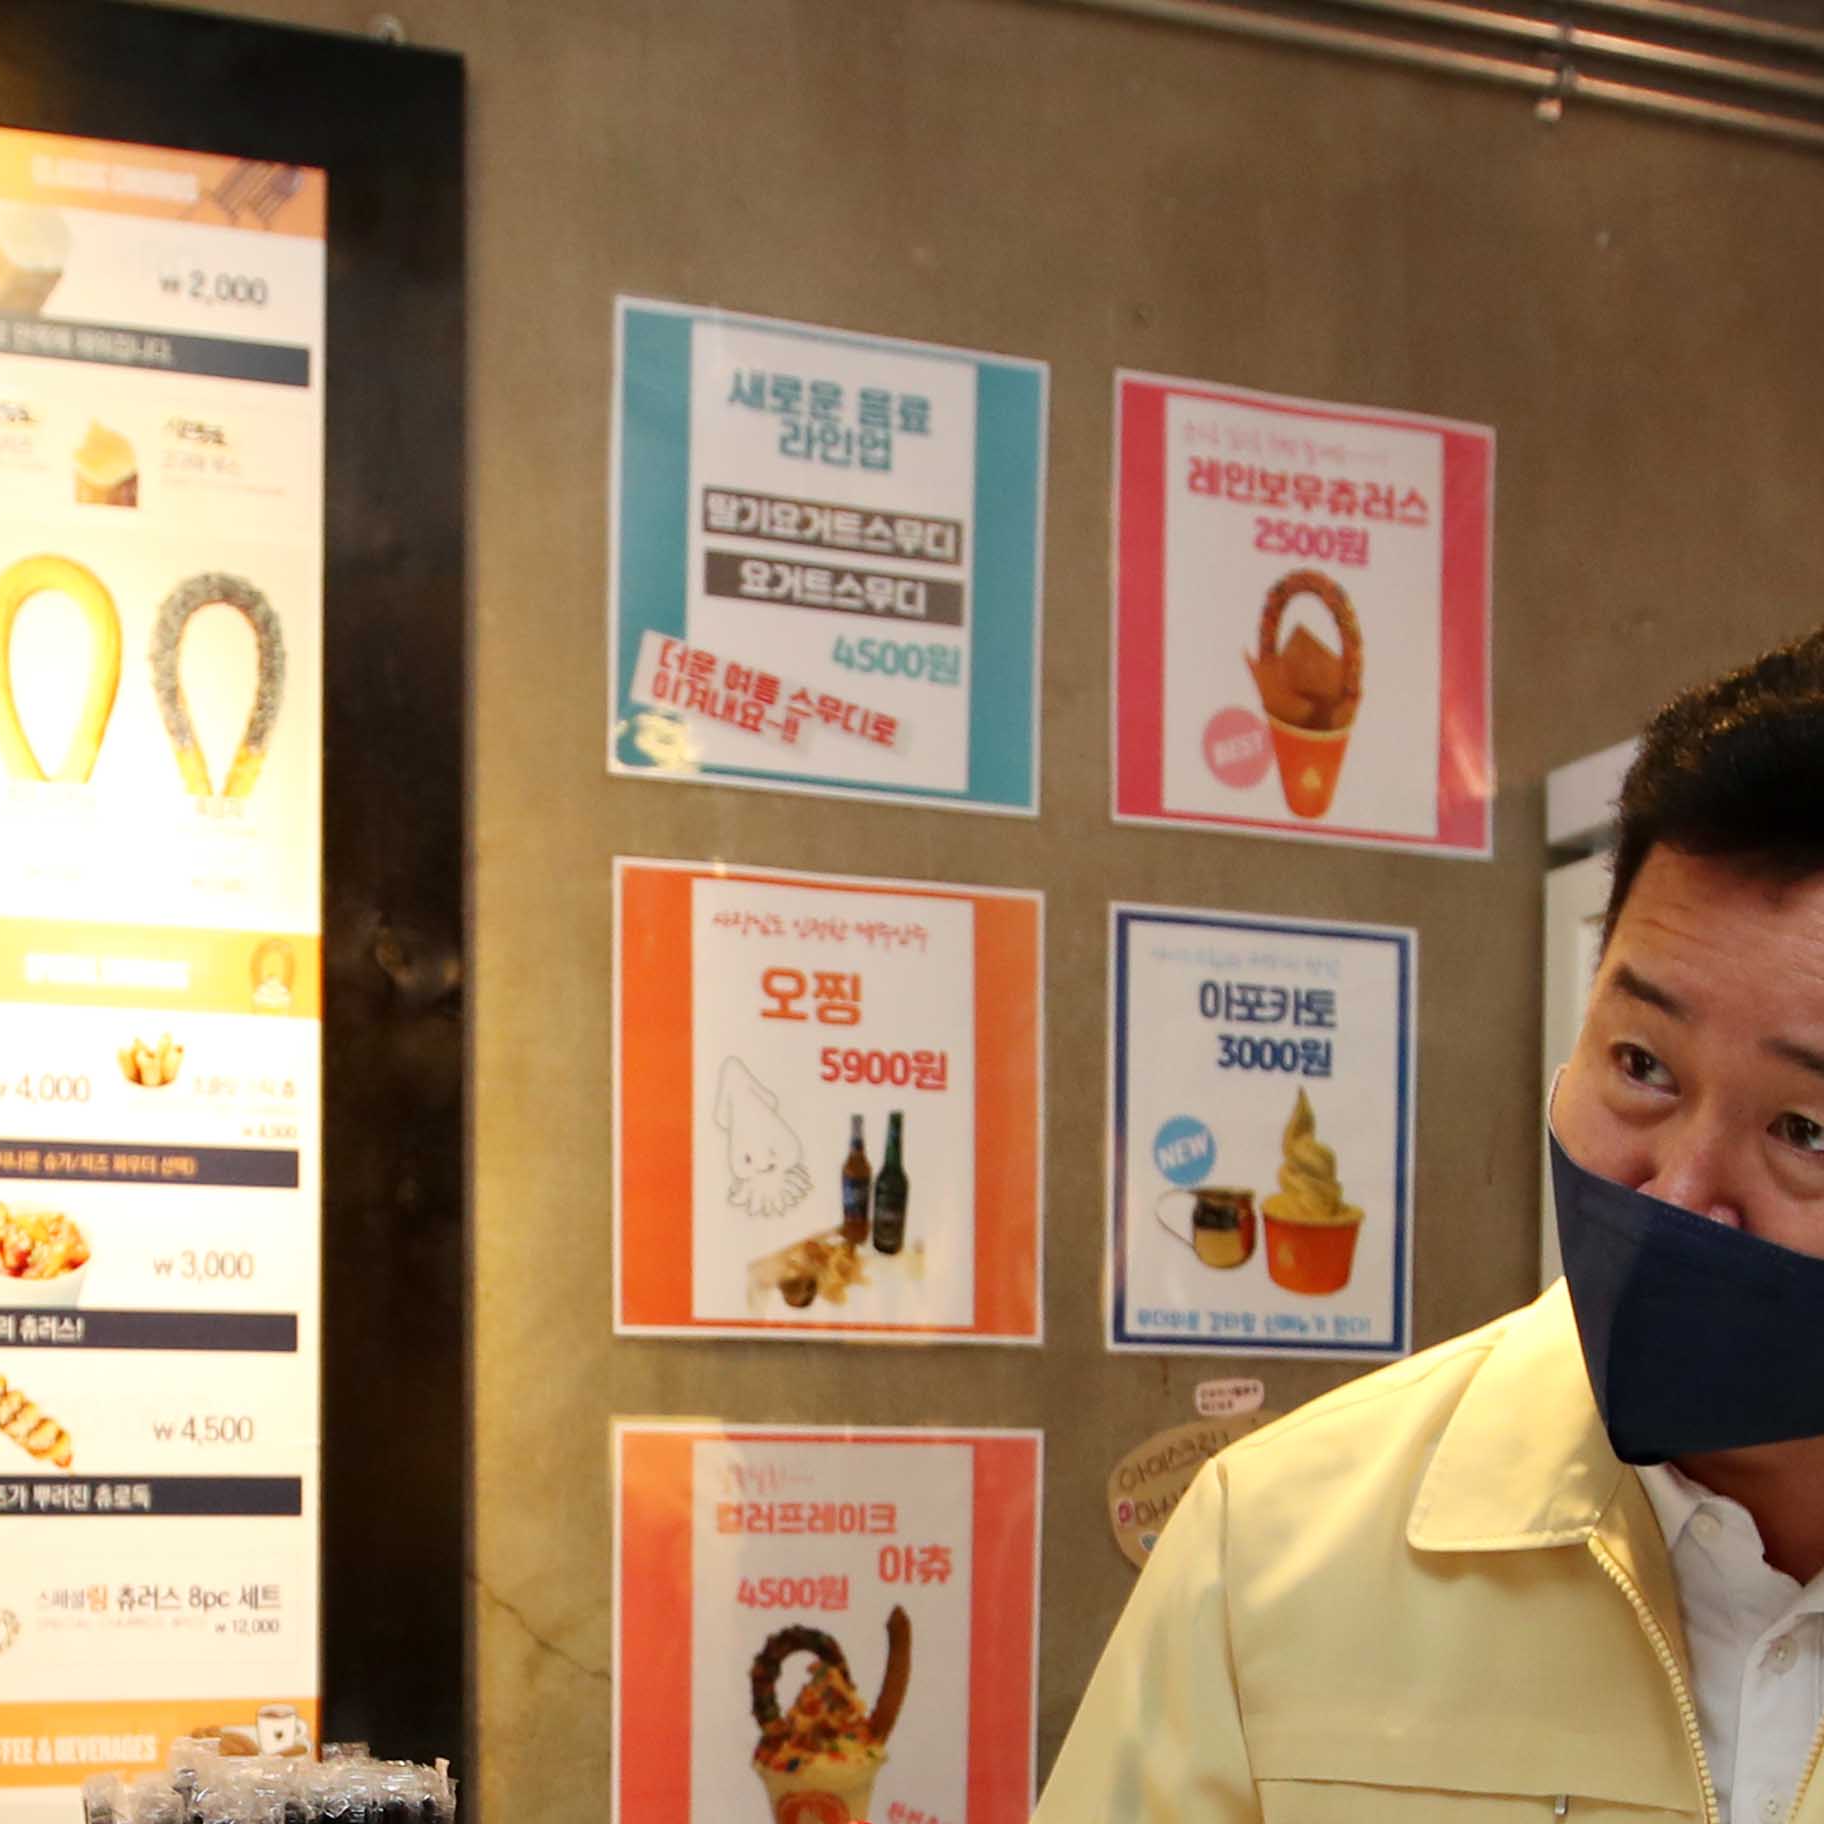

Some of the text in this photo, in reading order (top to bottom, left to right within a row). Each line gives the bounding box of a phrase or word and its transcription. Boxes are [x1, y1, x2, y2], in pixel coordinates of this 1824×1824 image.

[729, 369, 931, 435] 새로운 음료
[778, 419, 893, 472] 라인업
[1187, 455, 1429, 527] 레인보우츄러스
[707, 492, 957, 560] 딸기요거트스무디
[1253, 517, 1369, 567] 2500원
[739, 560, 925, 616] 요거트스무디
[831, 636, 961, 686] 4500원
[659, 640, 900, 748] 더운 여름 스무디로
[1199, 979, 1337, 1028] 아포카토
[820, 1047, 948, 1091] 5900원
[1217, 1034, 1332, 1078] 3000원
[1159, 1135, 1210, 1168] NEW
[180, 1250, 254, 1281] 3,000
[19, 1317, 85, 1343] 츄러스!
[181, 1415, 255, 1445] 4,500
[94, 1484, 152, 1510] 츄로독
[878, 1545, 952, 1585] 아츄
[737, 1575, 849, 1611] 4500원
[54, 1733, 158, 1766] BEVERAGES
